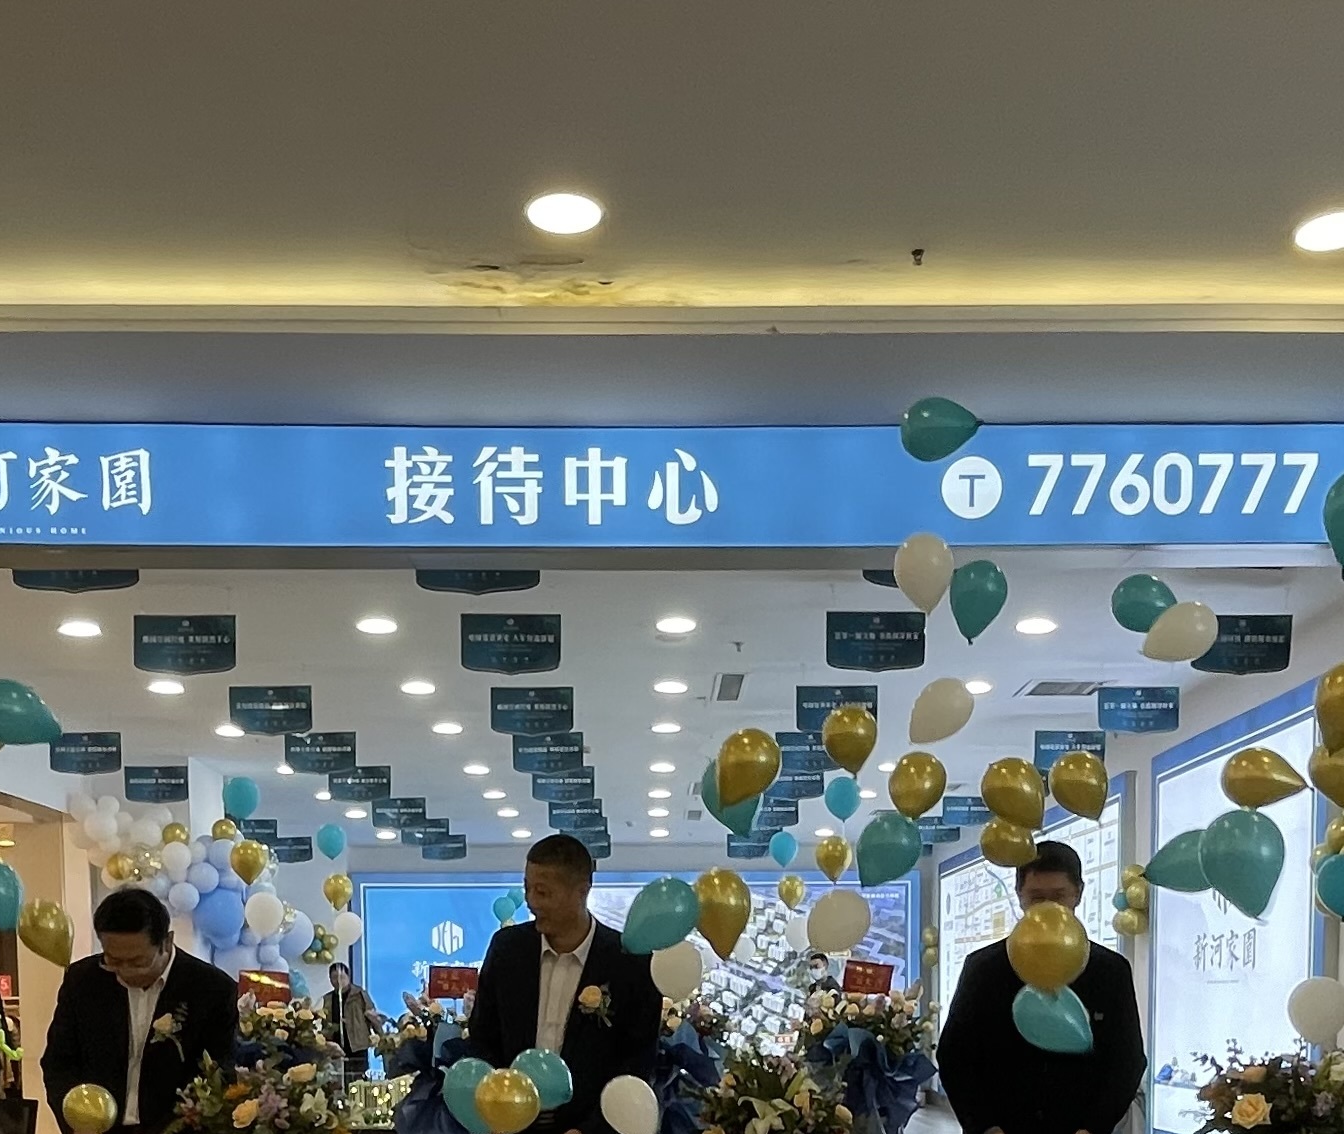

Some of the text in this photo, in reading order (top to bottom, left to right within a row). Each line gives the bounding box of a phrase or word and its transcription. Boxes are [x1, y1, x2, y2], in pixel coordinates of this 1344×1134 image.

[385, 446, 719, 526] 接待中心
[1027, 453, 1319, 517] 7760777
[50, 526, 88, 535] HOME
